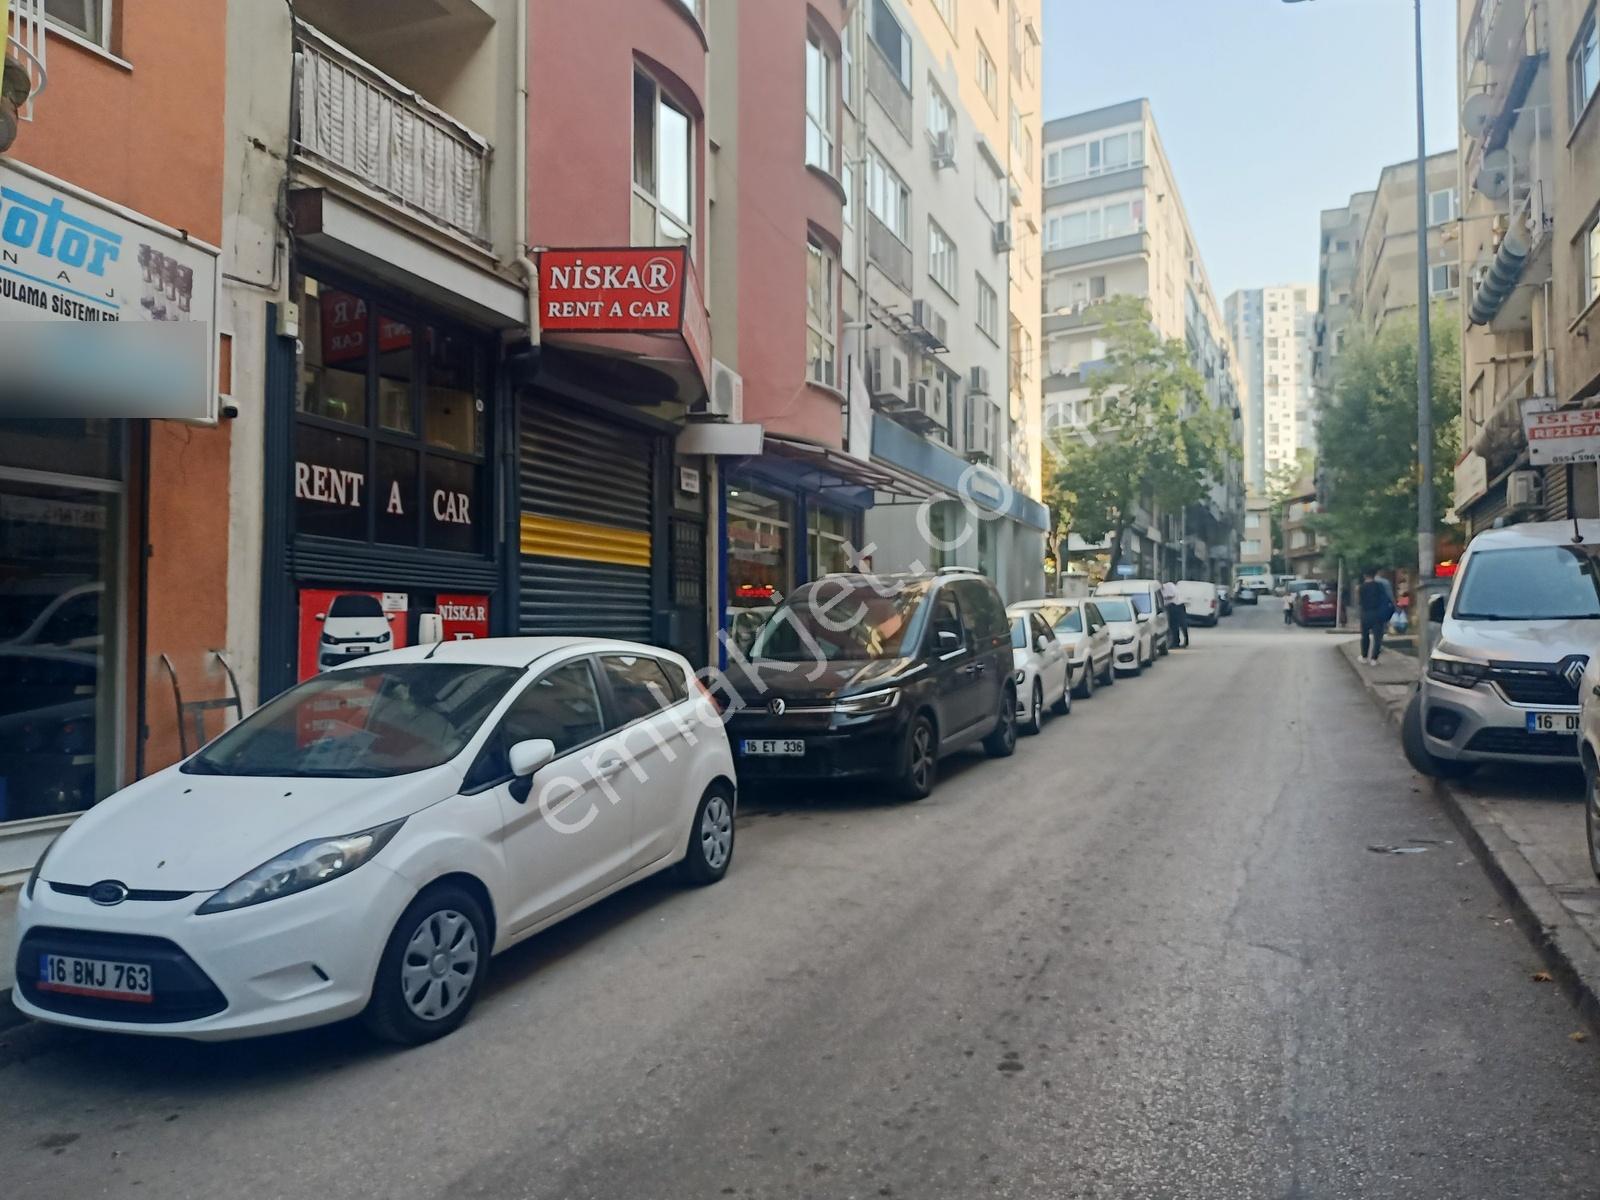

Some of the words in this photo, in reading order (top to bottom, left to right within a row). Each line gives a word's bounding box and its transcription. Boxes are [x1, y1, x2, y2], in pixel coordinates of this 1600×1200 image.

[0, 190, 122, 277] otor
[550, 259, 671, 291] NİSKAR
[0, 277, 48, 310] ULAMA
[547, 302, 604, 317] RENT
[608, 302, 623, 317] A
[629, 302, 670, 317] CAR
[295, 461, 364, 507] RENT
[387, 480, 404, 514] A
[433, 489, 471, 524] CAR
[438, 601, 486, 621] NİSKAR
[1537, 715, 1552, 729] 16
[746, 741, 757, 752] 16
[762, 741, 776, 752] ET
[49, 958, 66, 982] 16
[73, 960, 107, 987] BNJ
[113, 965, 149, 991] 763
